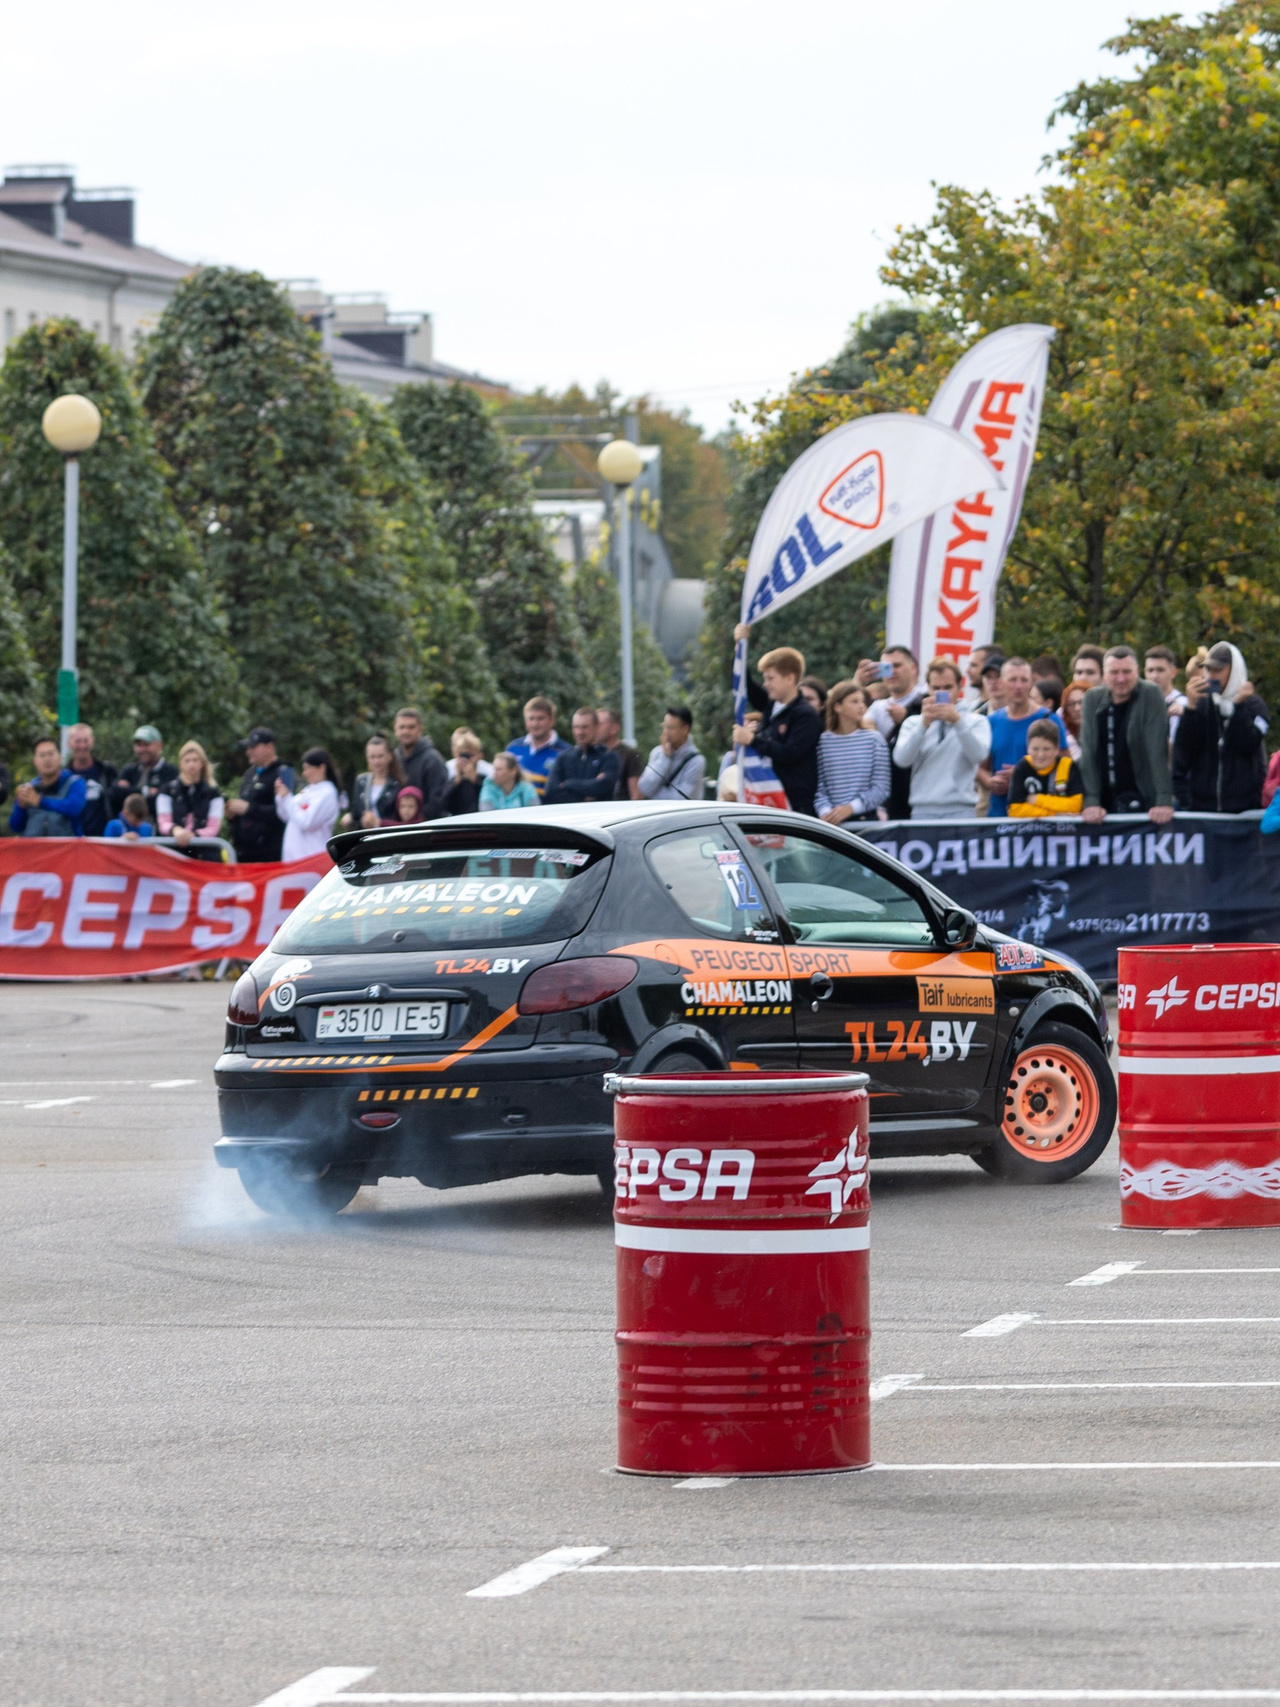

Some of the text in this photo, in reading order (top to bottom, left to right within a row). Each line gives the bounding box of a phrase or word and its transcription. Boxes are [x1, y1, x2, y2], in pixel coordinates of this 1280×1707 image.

[725, 866, 760, 906] 12
[1, 871, 323, 950] CEPSA
[434, 957, 531, 976] TL24.BY
[689, 948, 852, 973] PEUGEOT SPORT
[919, 982, 994, 1008] Taif lubricants
[319, 1023, 331, 1034] BY
[335, 1006, 384, 1034] 3510
[844, 1019, 978, 1067] TL24.BY
[614, 1145, 756, 1202] EPSA
